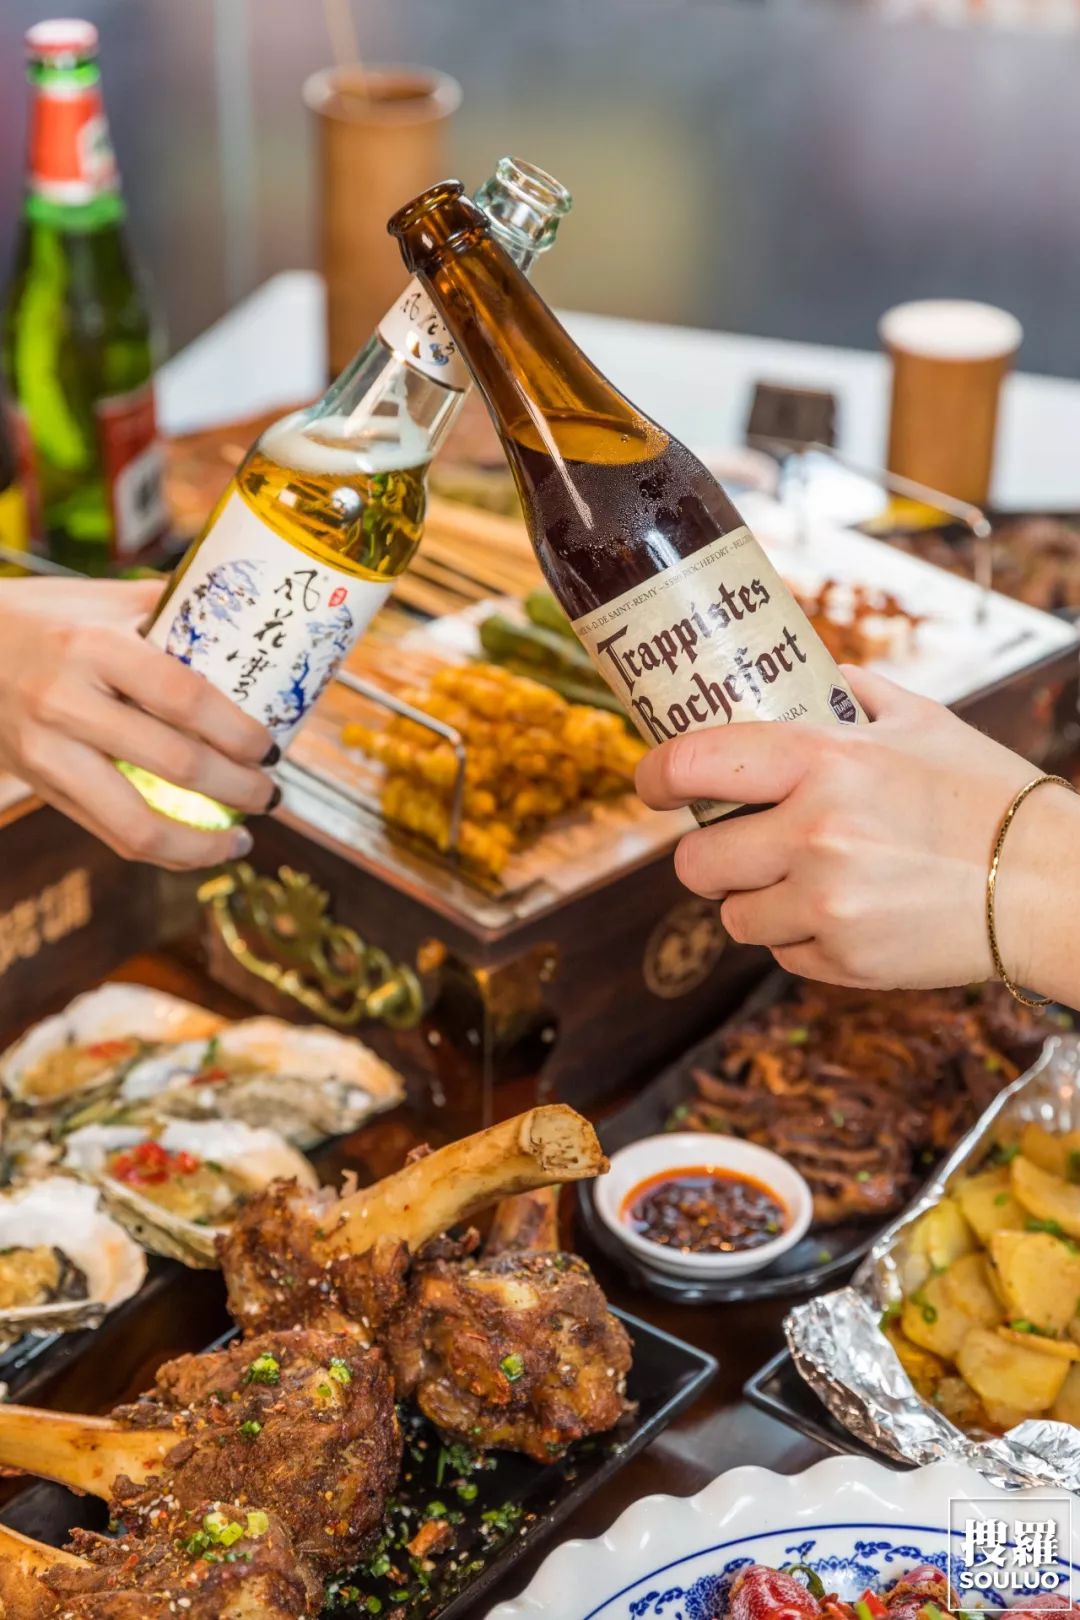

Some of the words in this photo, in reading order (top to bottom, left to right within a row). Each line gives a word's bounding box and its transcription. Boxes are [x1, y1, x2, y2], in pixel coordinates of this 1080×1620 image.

[596, 578, 771, 696] Trappistes
[607, 586, 658, 620] SAINT-REMY
[631, 626, 807, 745] Rochefort
